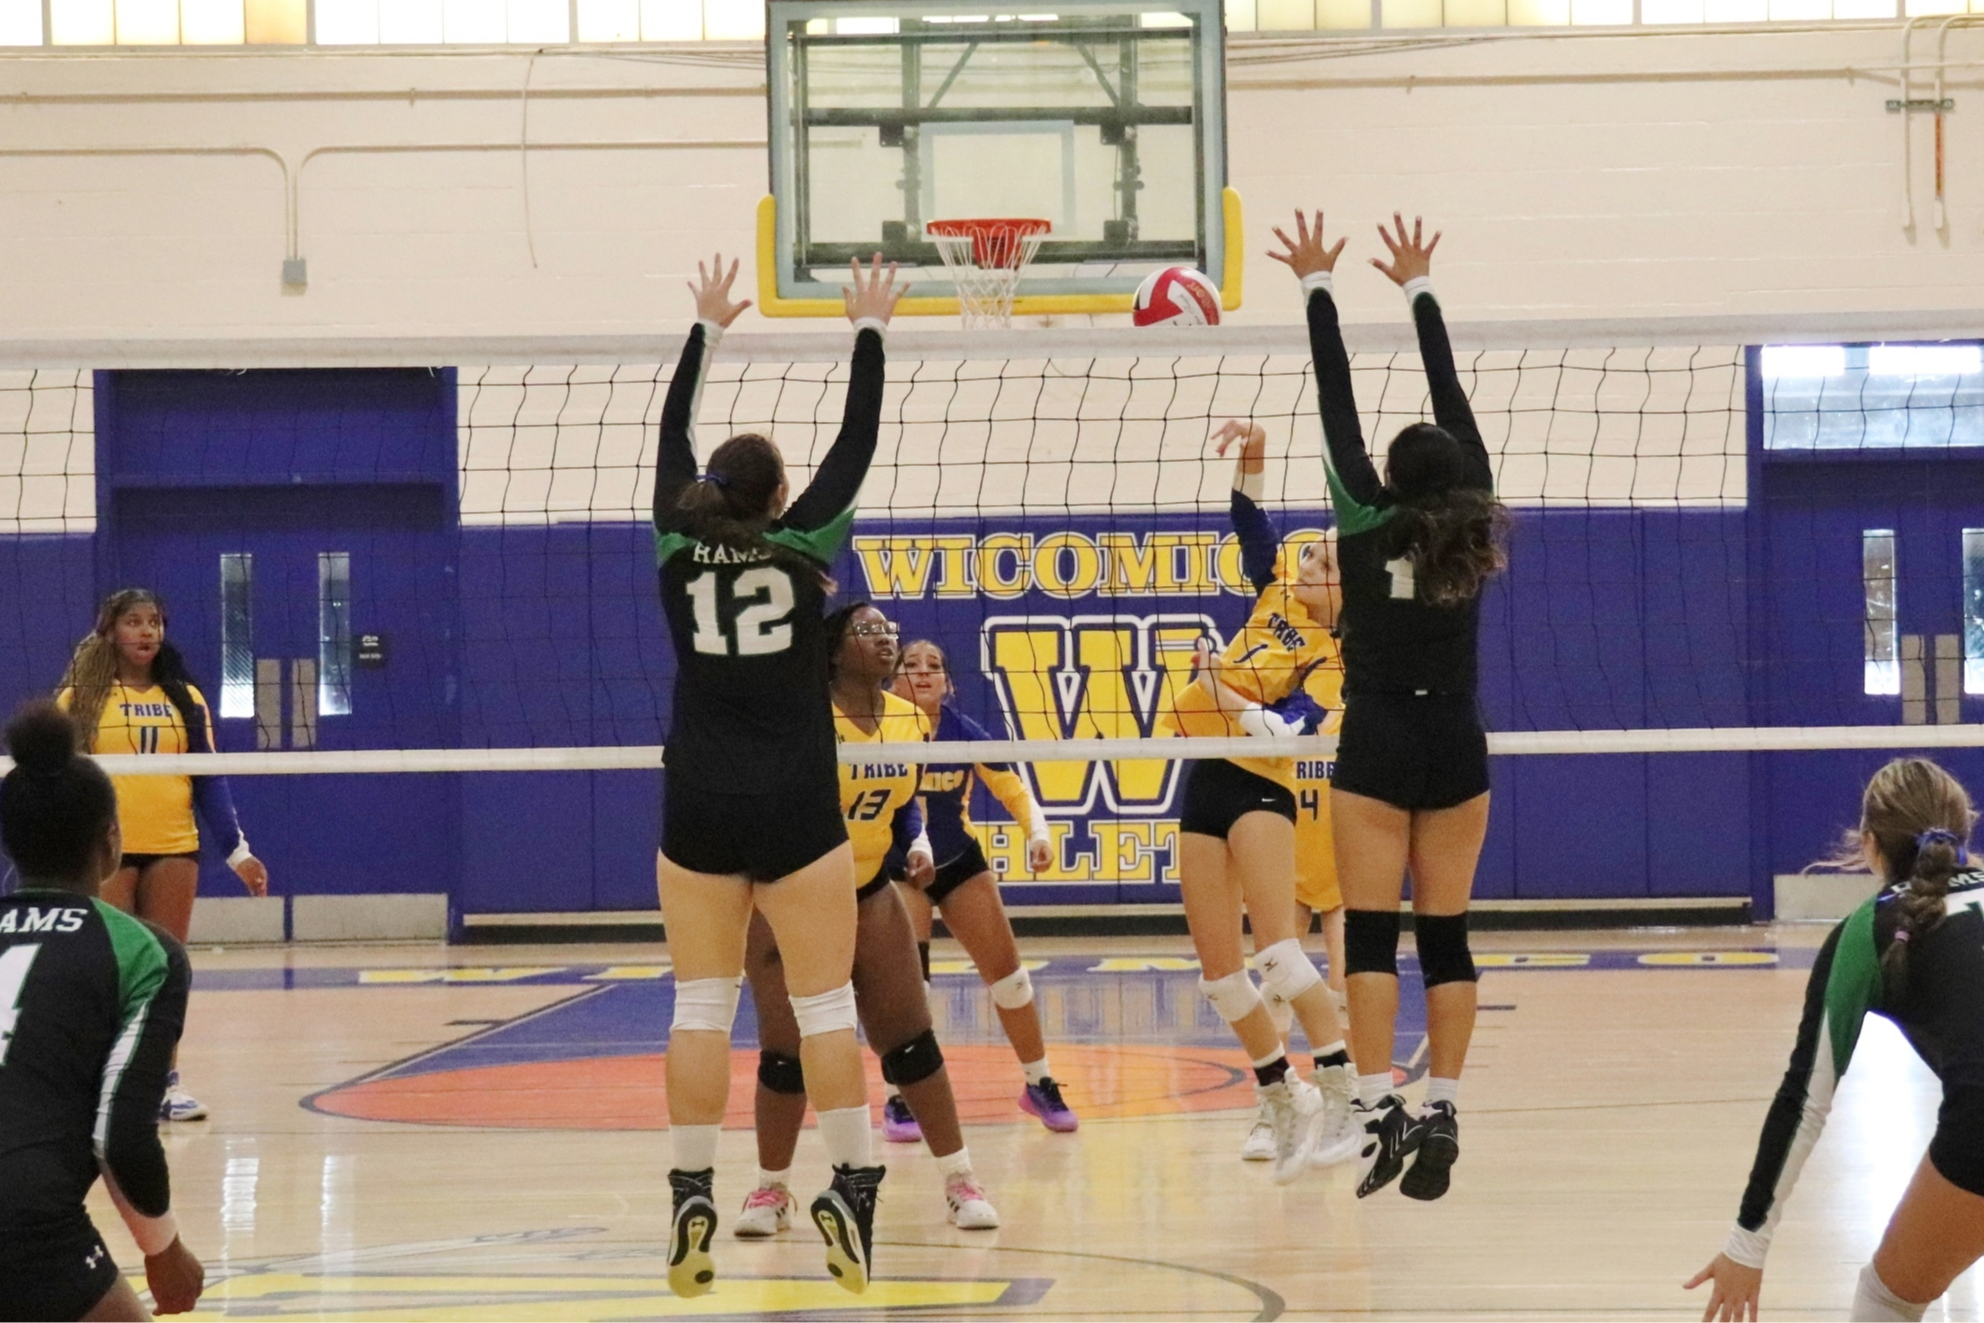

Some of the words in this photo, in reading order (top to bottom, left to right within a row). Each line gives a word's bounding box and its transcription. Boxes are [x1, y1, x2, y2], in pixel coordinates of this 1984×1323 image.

[686, 567, 795, 655] 12
[120, 703, 172, 718] TRIBE
[981, 614, 1226, 815] W
[141, 726, 158, 754] 11
[849, 763, 908, 780] TRIBE
[848, 789, 892, 820] 13
[1300, 788, 1319, 821] 4
[0, 907, 88, 933] AMS
